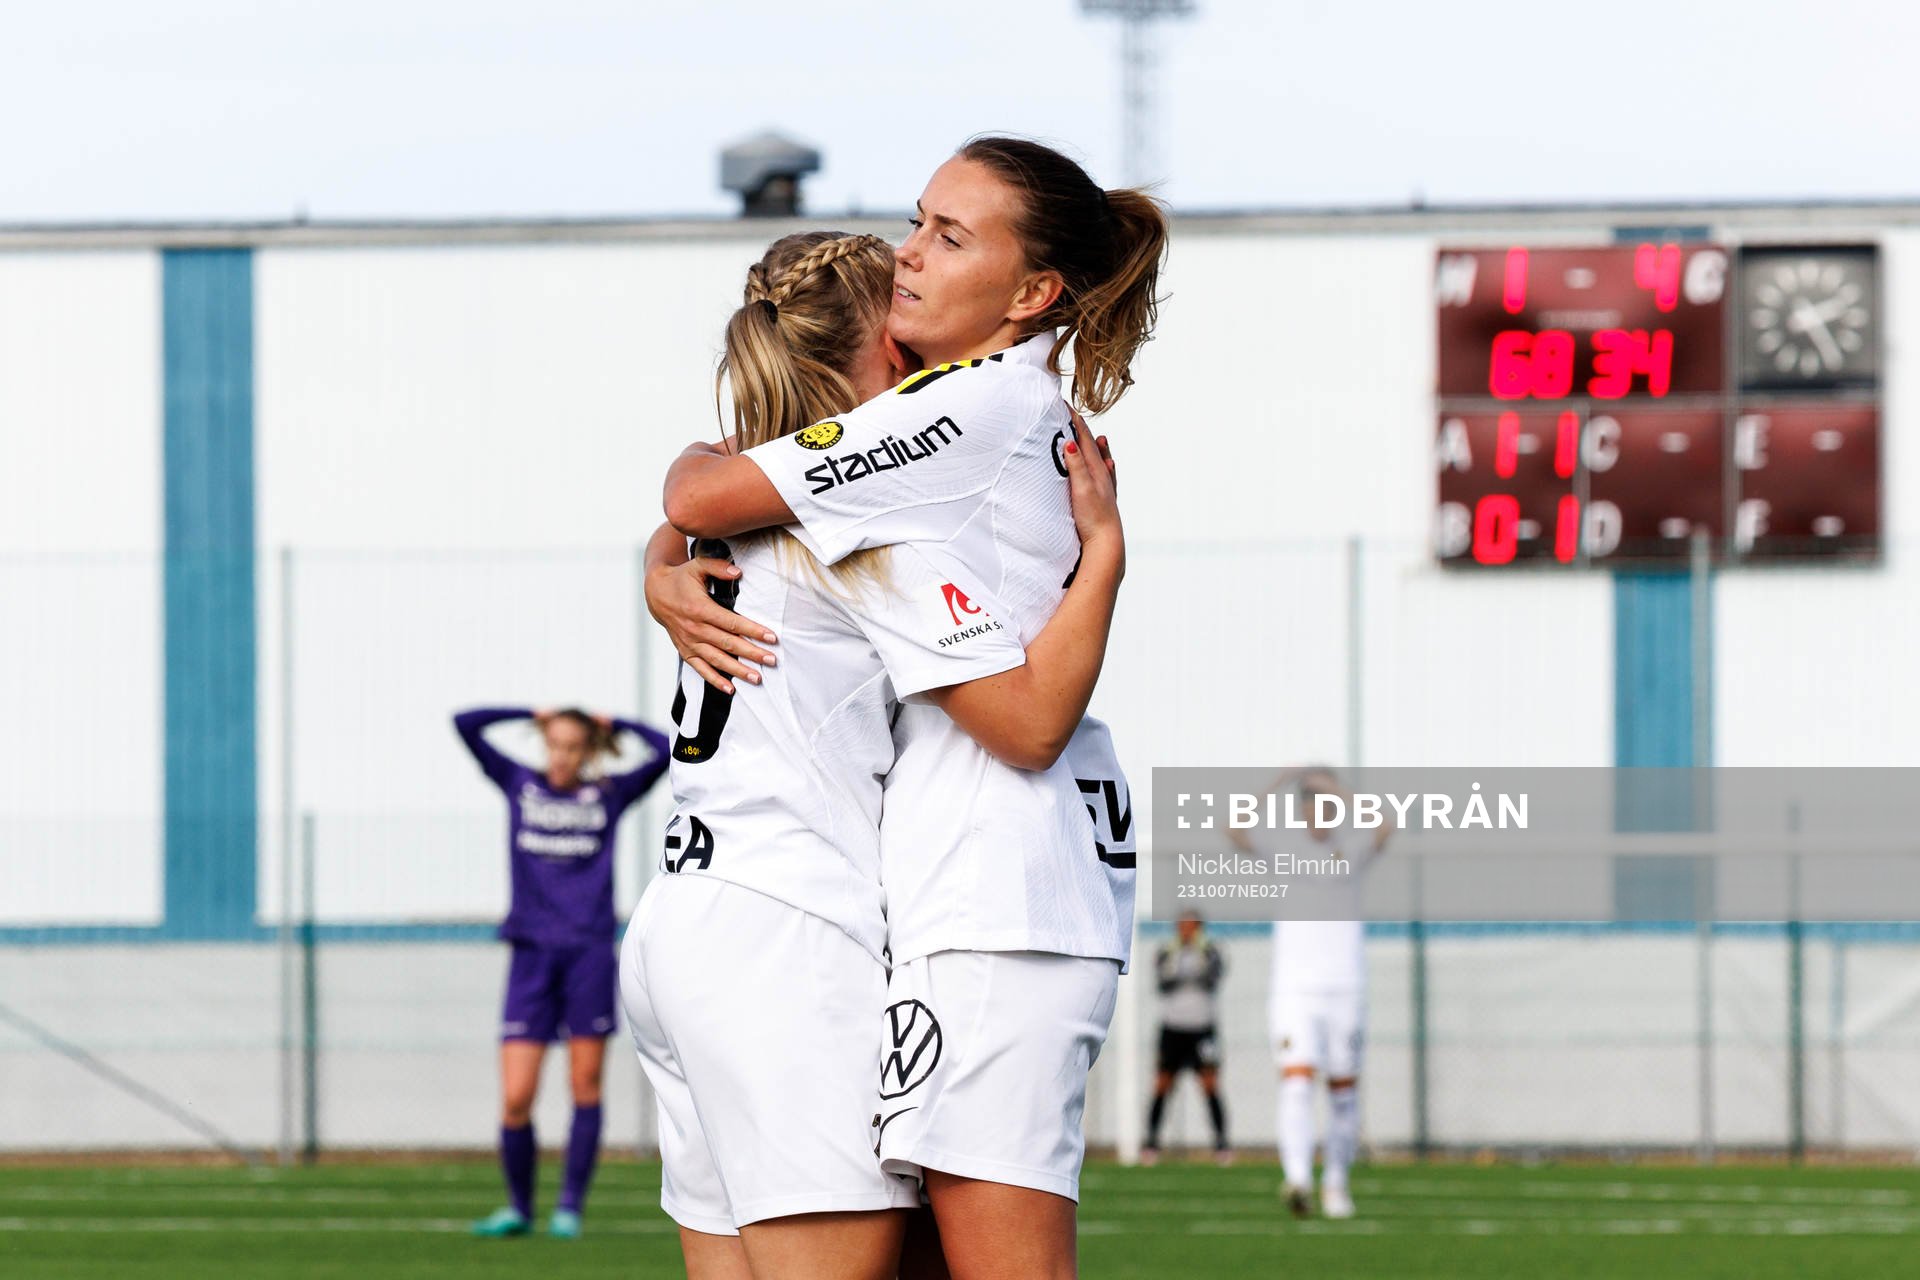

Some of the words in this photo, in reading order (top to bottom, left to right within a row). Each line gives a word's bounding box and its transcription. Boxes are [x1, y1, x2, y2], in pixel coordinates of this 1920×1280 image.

[1503, 246, 1528, 314] 1
[1634, 243, 1681, 312] 4
[1588, 329, 1673, 398] 34
[804, 415, 964, 495] stadium
[1438, 418, 1472, 472] A
[1495, 411, 1520, 478] 1
[1555, 411, 1579, 478] 1
[1473, 494, 1520, 565] 0
[1555, 495, 1579, 563] 1
[938, 623, 993, 648] SVENSKA
